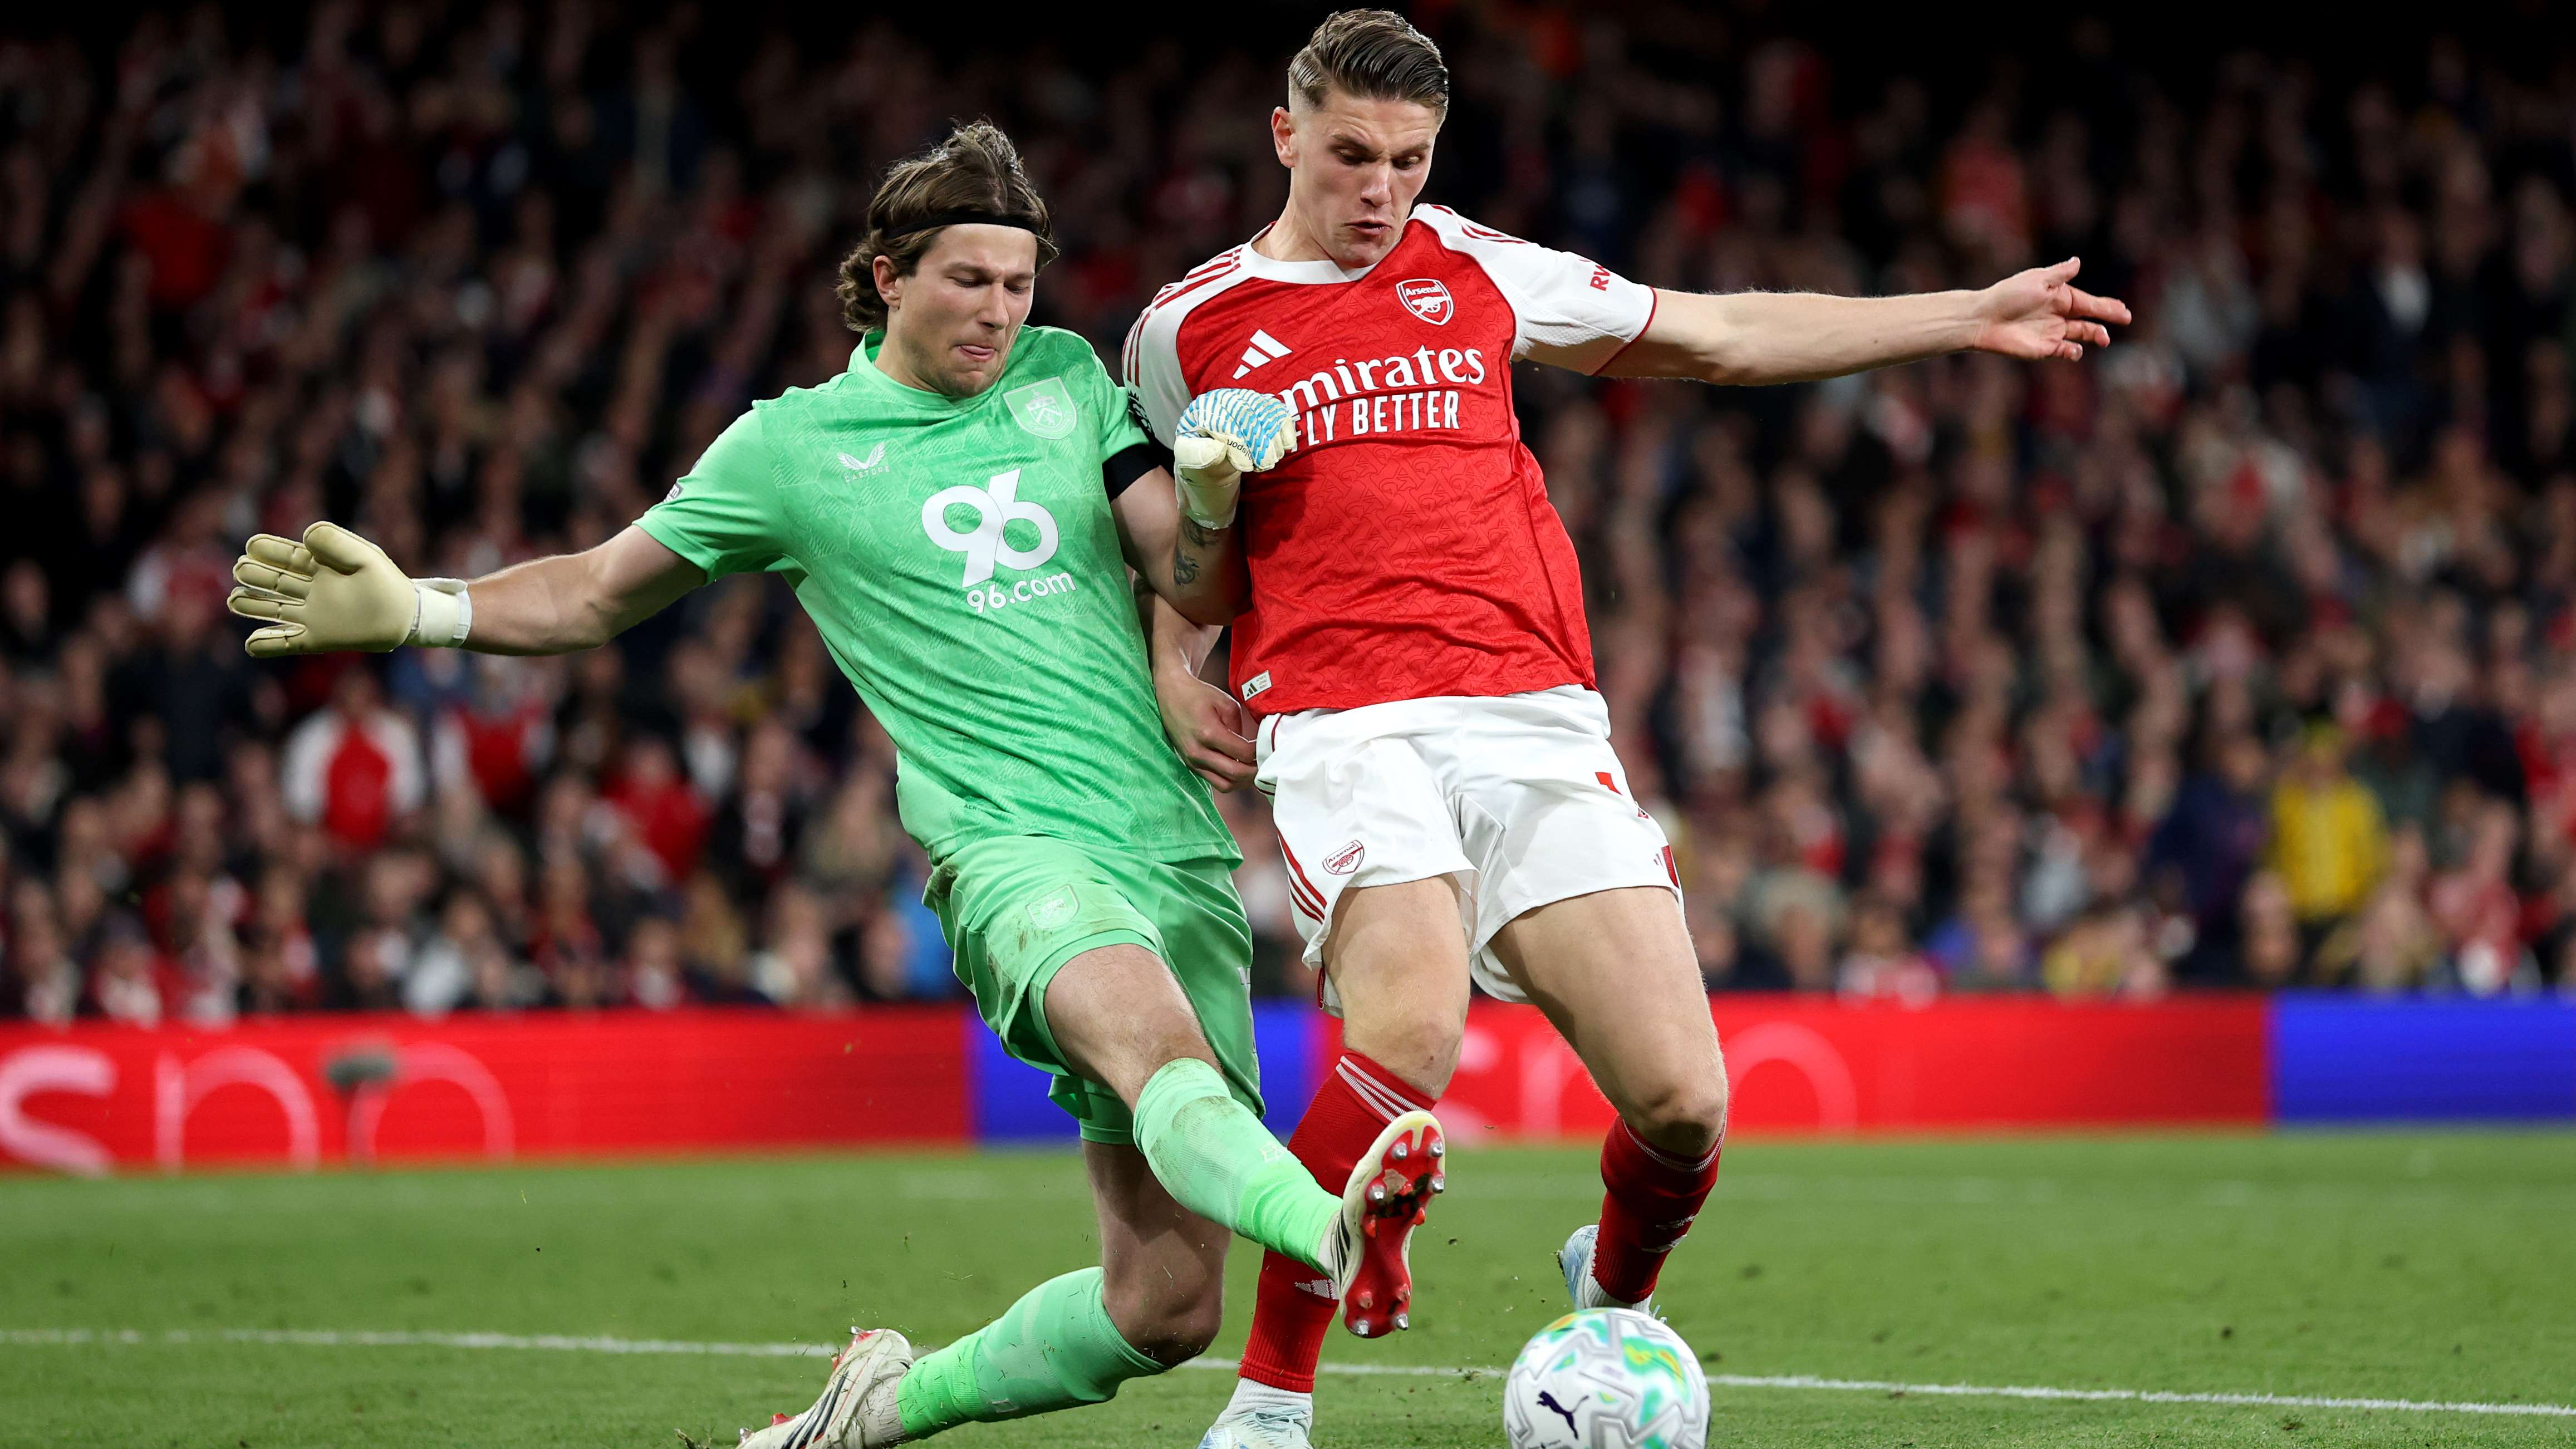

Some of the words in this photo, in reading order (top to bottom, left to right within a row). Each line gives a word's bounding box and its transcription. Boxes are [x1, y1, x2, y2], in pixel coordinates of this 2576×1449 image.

[1405, 284, 1441, 297] Arsenal
[1265, 344, 1485, 417] mirates
[1352, 390, 1460, 435] BETTER
[845, 464, 890, 483] CASTORE
[921, 467, 1059, 588] 96
[966, 572, 1077, 614] 96.com
[1328, 844, 1355, 863] Arsenal
